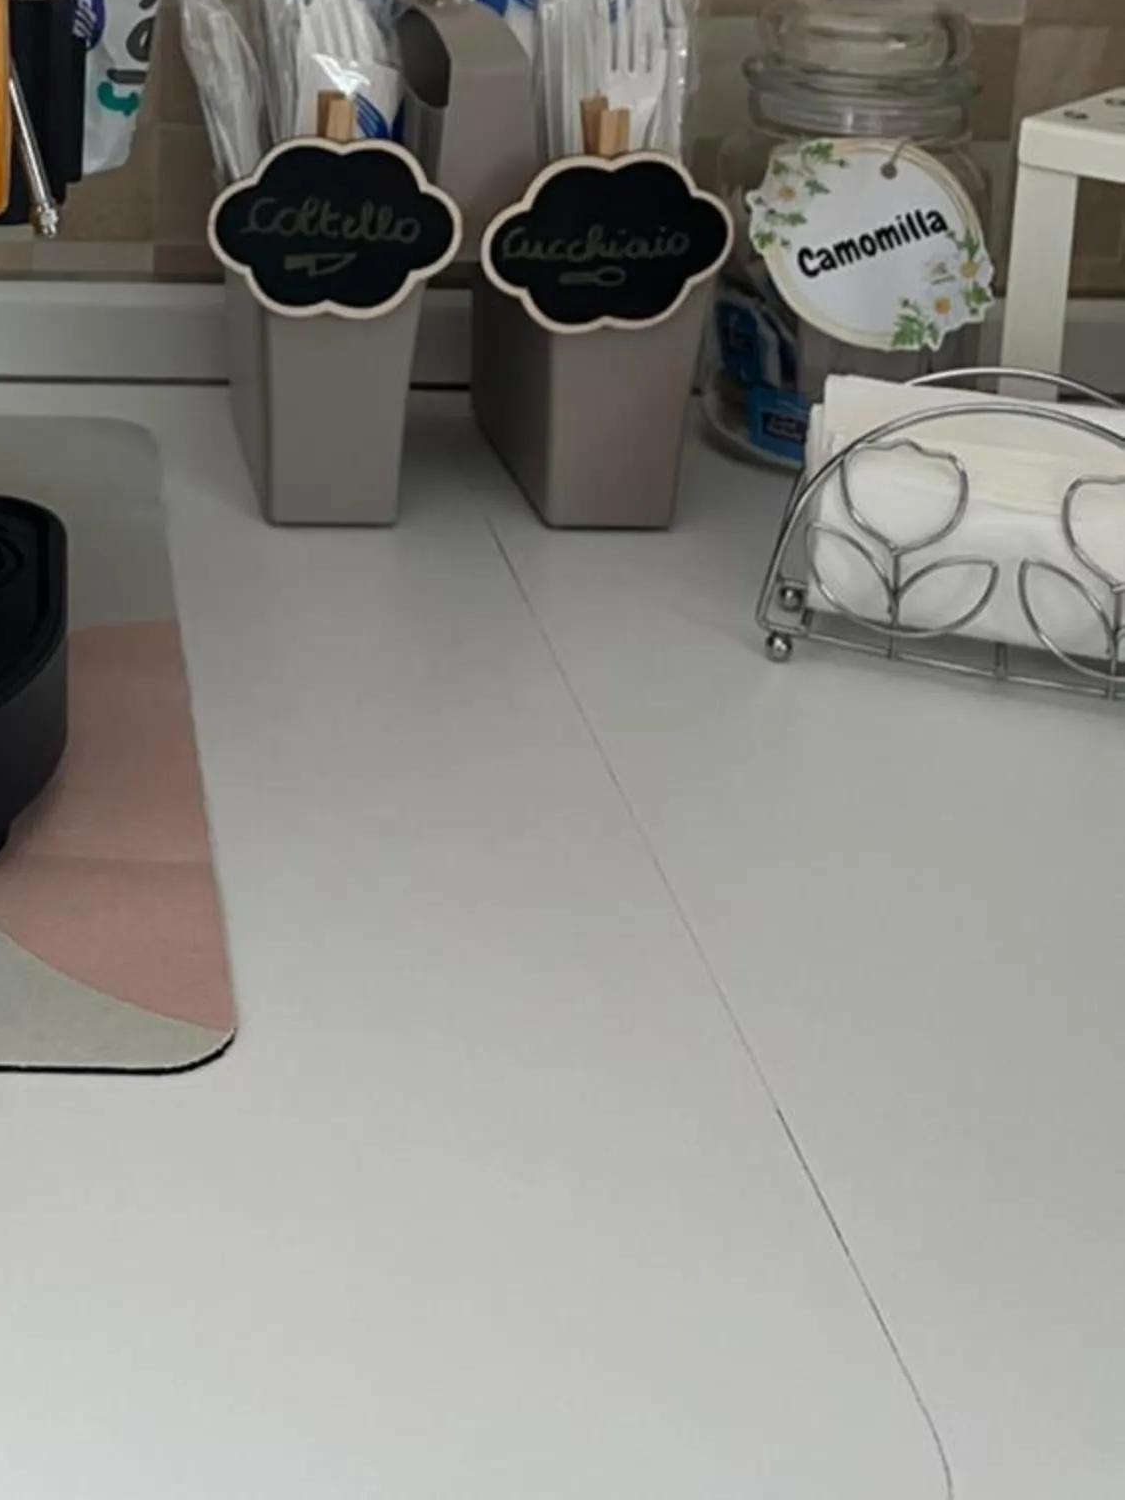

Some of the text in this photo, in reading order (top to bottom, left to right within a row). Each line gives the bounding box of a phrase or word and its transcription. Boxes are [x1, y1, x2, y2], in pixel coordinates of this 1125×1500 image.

[239, 196, 421, 244] Coltello
[500, 224, 691, 263] Cucchiaio
[797, 207, 949, 278] Camomilla
